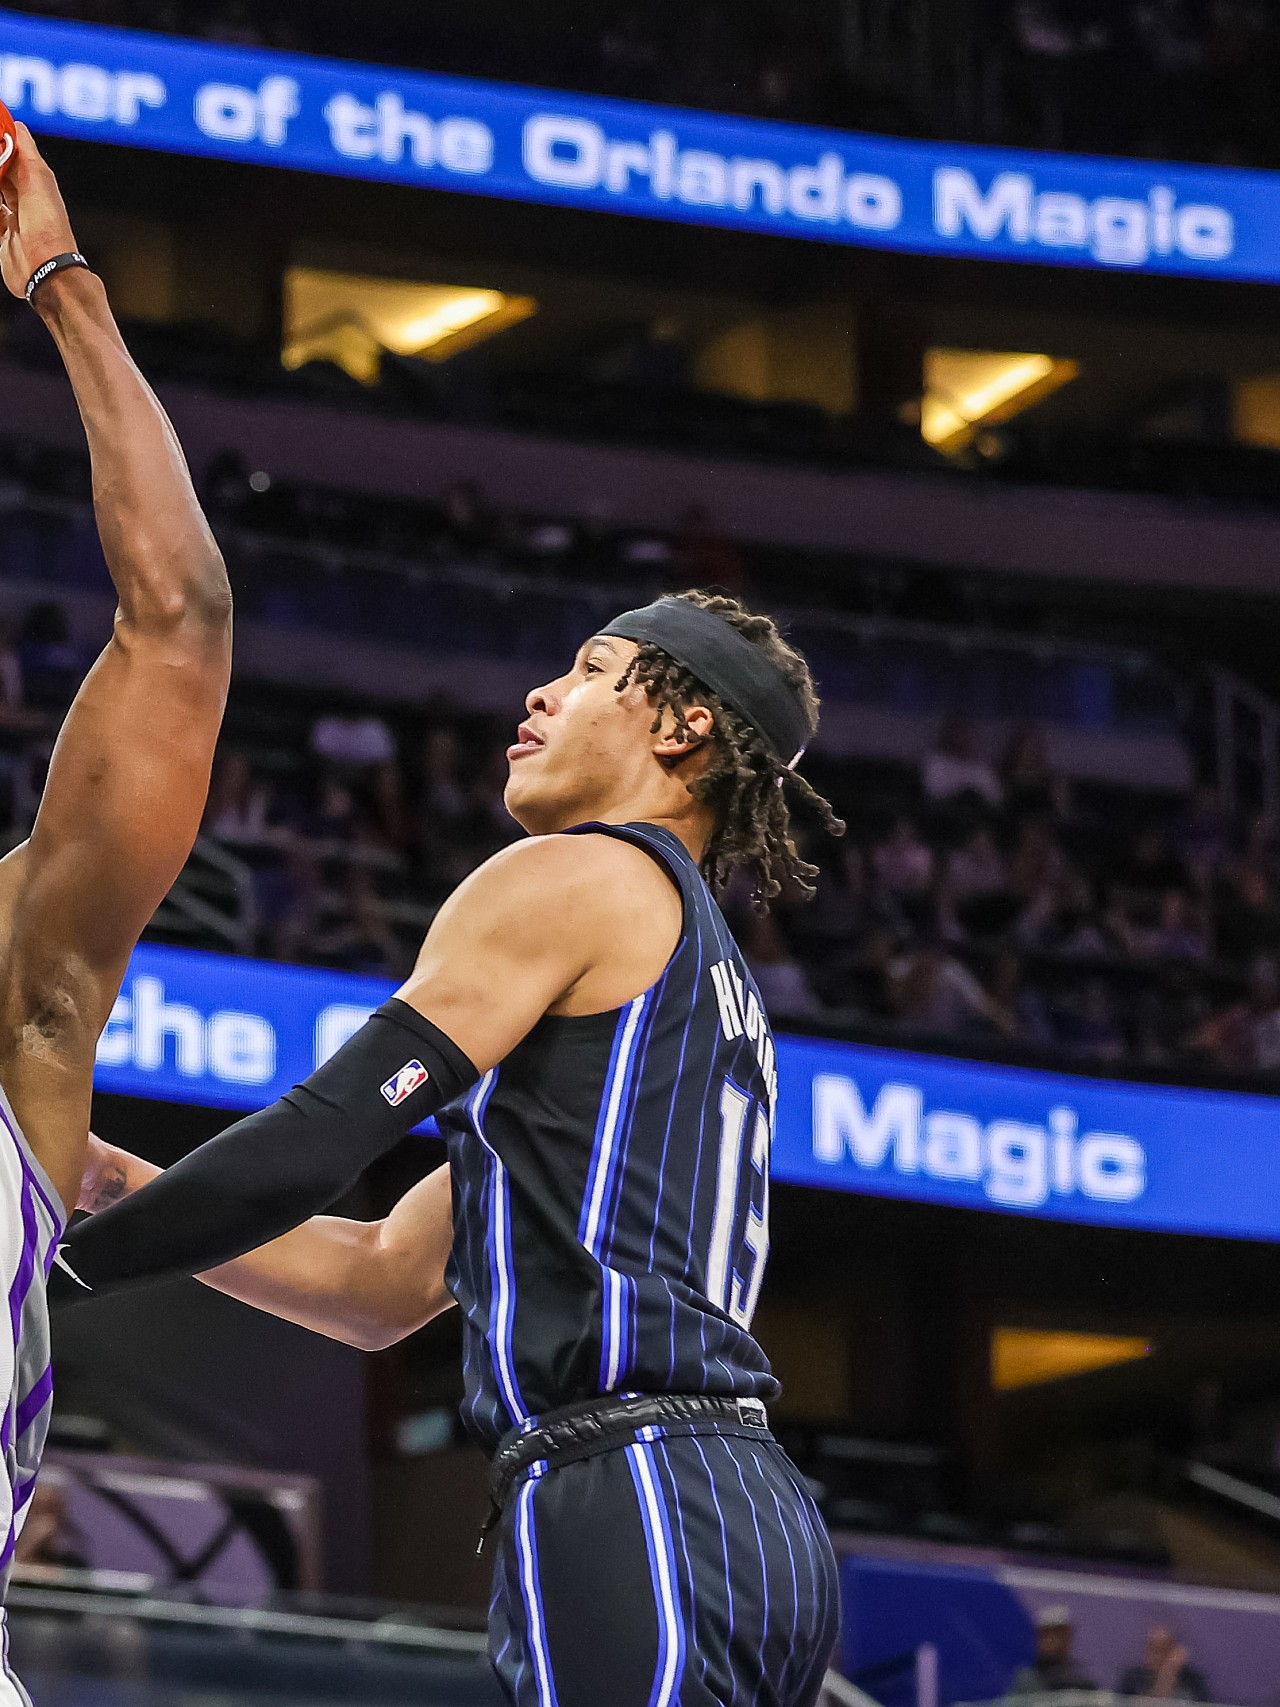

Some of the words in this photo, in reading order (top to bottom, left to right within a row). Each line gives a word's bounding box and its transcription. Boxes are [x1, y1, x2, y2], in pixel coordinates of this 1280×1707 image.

[194, 76, 299, 146] of
[325, 93, 492, 175] the
[523, 114, 901, 230] Orlando
[932, 168, 1233, 266] Magic
[34, 261, 57, 284] MIND
[812, 1073, 1147, 1208] Magic
